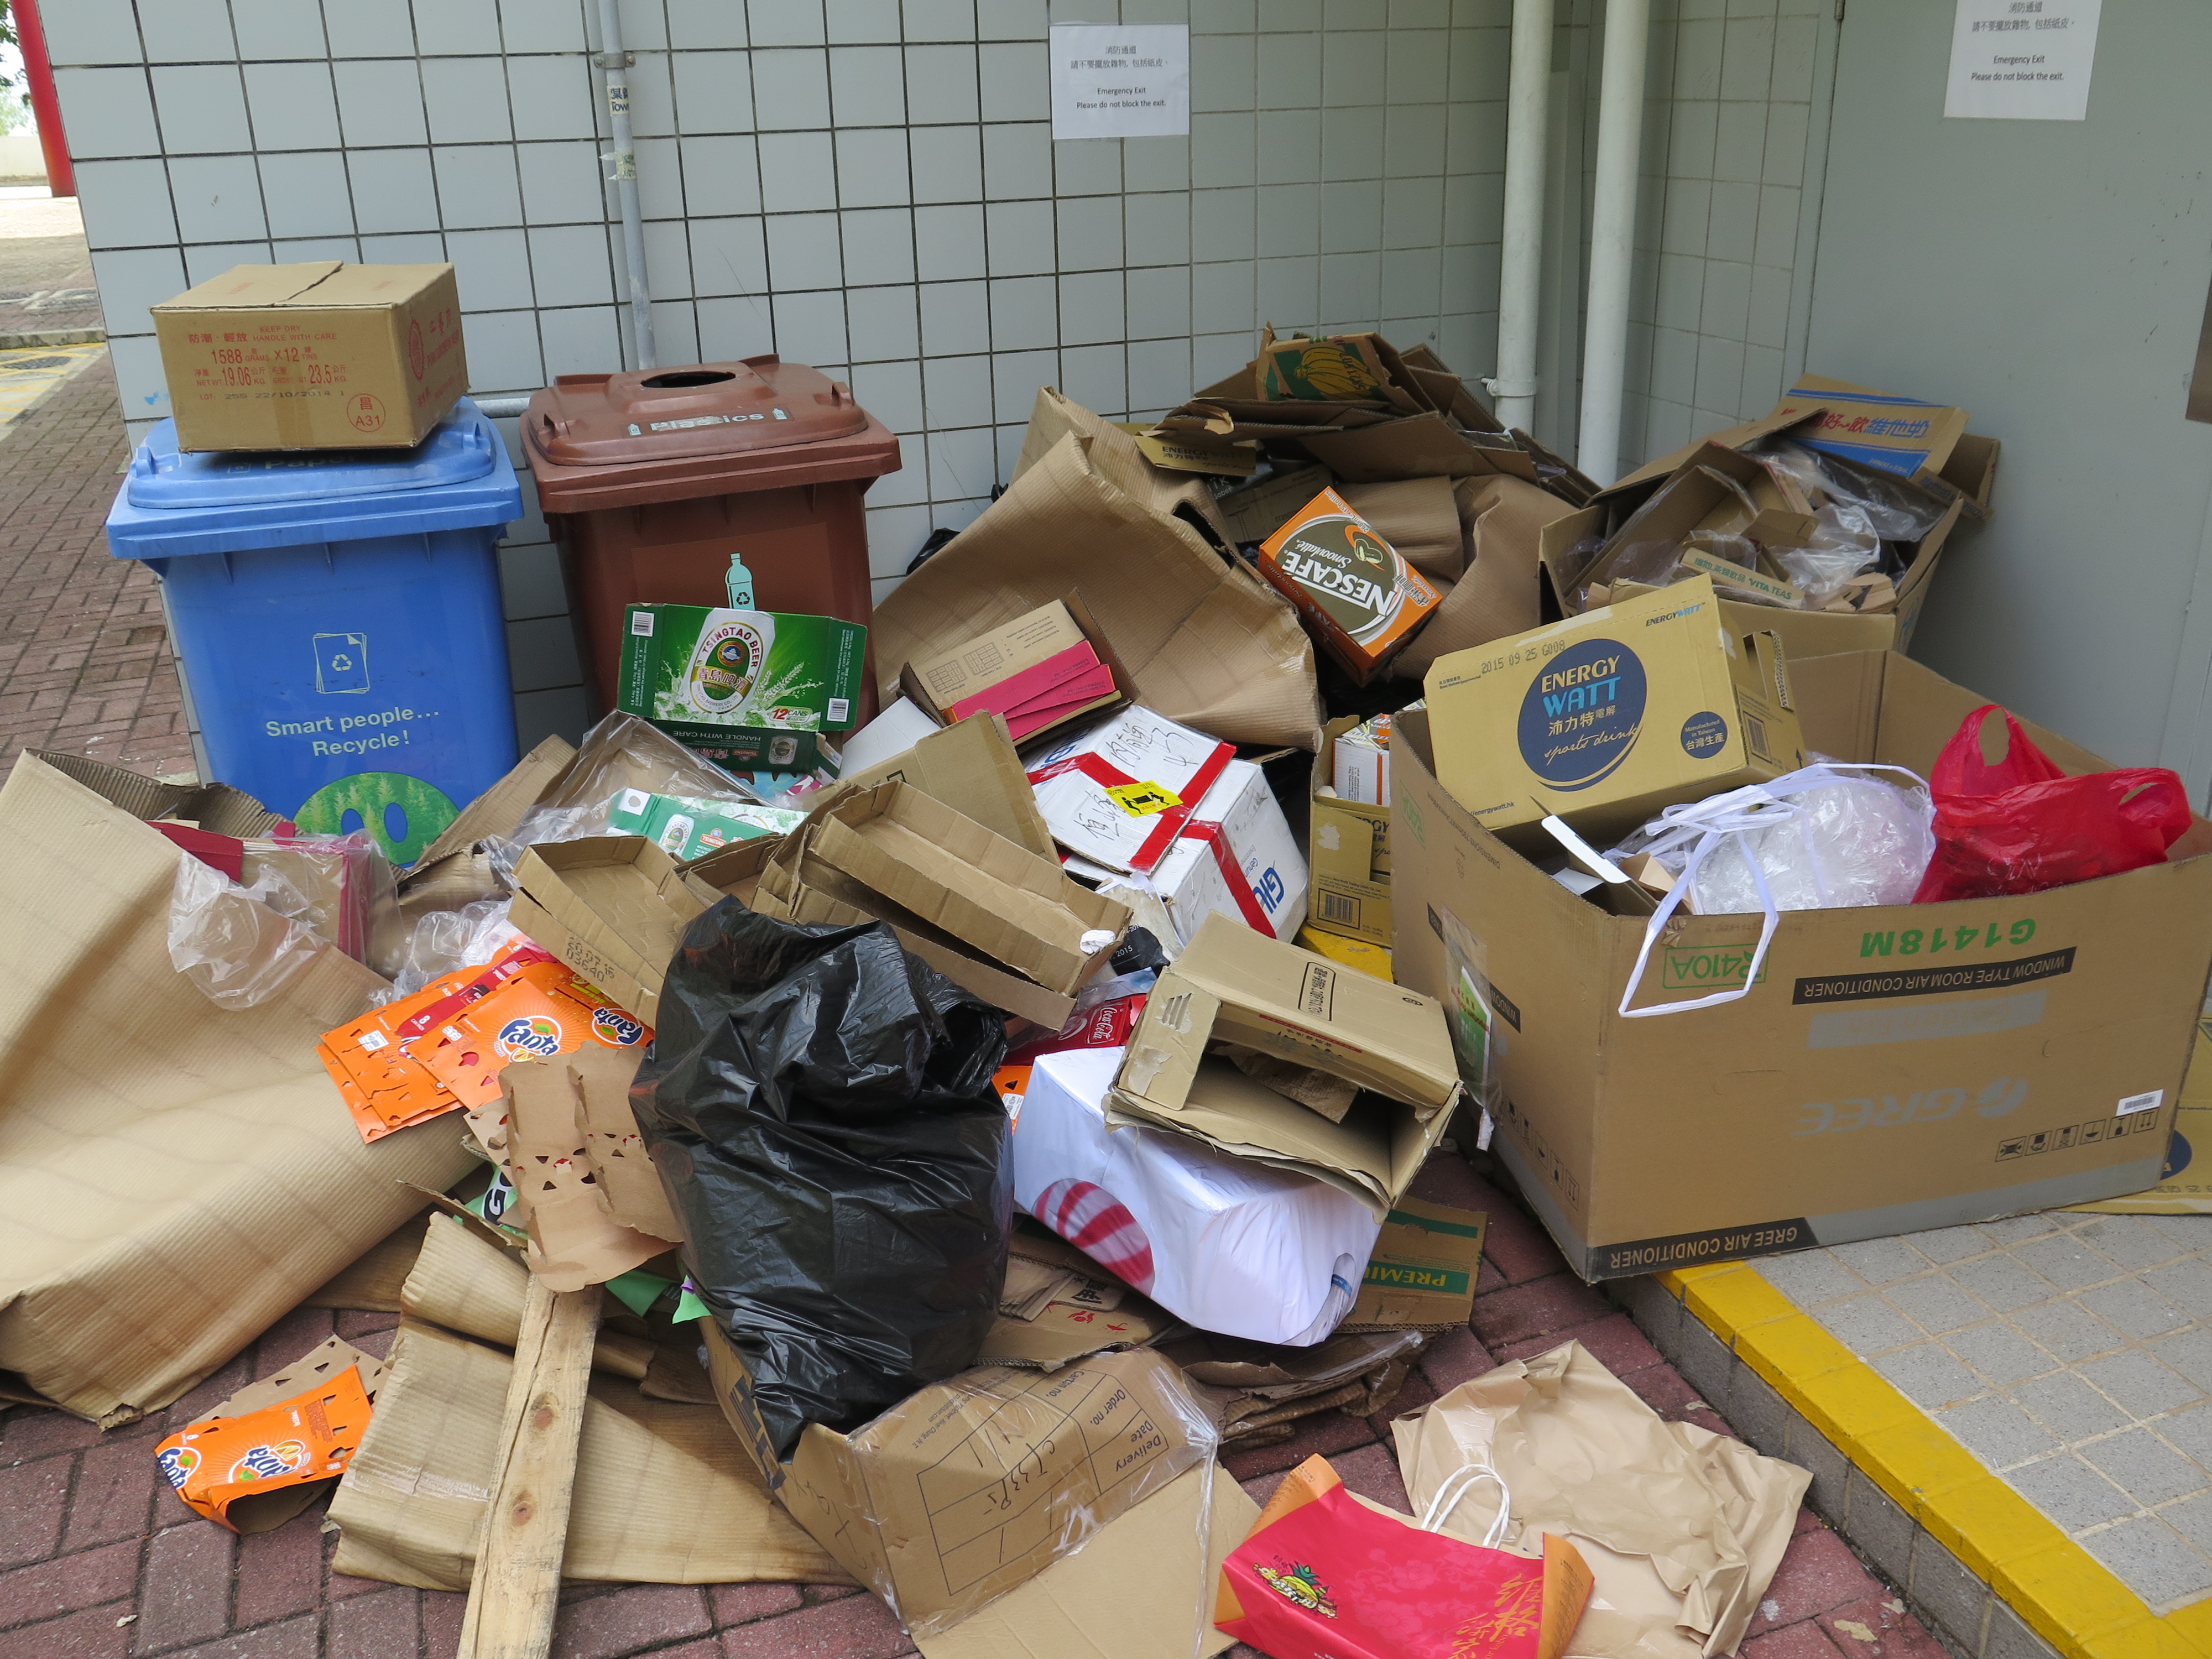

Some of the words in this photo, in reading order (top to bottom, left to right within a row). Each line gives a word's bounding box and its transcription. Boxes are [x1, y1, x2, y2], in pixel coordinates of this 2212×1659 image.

[1105, 45, 1136, 55] 消防通道
[1993, 55, 2031, 65] Emergency
[2032, 55, 2045, 63] Exit
[1971, 72, 1992, 81] Please
[2016, 72, 2035, 80] block
[211, 348, 243, 364] 1588
[222, 367, 252, 386] 19.06
[308, 364, 332, 384] 23.5
[251, 367, 266, 375] 公斤
[254, 390, 331, 399] 22/10/2014
[360, 397, 373, 411] 昌
[355, 415, 381, 428] A31
[1864, 418, 1931, 438] 維他奶
[1771, 586, 1792, 599] TEAS
[702, 627, 752, 654] TSINGTAO
[749, 640, 760, 668] BEER
[1481, 657, 1504, 674] 2015
[1509, 652, 1520, 666] 09
[1525, 648, 1537, 661] 25
[697, 667, 749, 692] 青島啤酒
[1541, 654, 1621, 693] ENERGY
[1542, 676, 1622, 718] WATT
[772, 708, 789, 720] 12
[787, 708, 808, 717] CANS
[265, 716, 334, 737] Smart
[1684, 719, 1720, 733] Manufactured
[1698, 727, 1716, 737] Taiwan
[697, 732, 722, 740] WITH
[724, 733, 761, 742] HANDLE
[1544, 733, 1599, 766] sports
[1593, 722, 1639, 747] drink
[1685, 732, 1725, 751] 台灣生產
[701, 834, 726, 847] TSINGTAO
[1859, 918, 2037, 958] G1418M
[1115, 945, 1134, 958] 2015
[1978, 966, 2011, 983] TYPE
[2015, 955, 2066, 979] WINDOW
[1804, 974, 1903, 998] CONDITIONER
[419, 1015, 431, 1025] 8
[592, 1006, 644, 1045] Fanta
[497, 1018, 560, 1056] Fanta
[1791, 1086, 1968, 1139] GREE
[1724, 1234, 1751, 1251] AIR
[1754, 1227, 1798, 1248] GREE
[1610, 1237, 1720, 1269] CONDITIONER
[1059, 1370, 1086, 1389] Carton
[1046, 1386, 1062, 1397] no.
[1105, 1389, 1126, 1415] Order
[1089, 1411, 1104, 1425] no.
[1131, 1420, 1154, 1443] Date
[1115, 1434, 1161, 1472] Delivery
